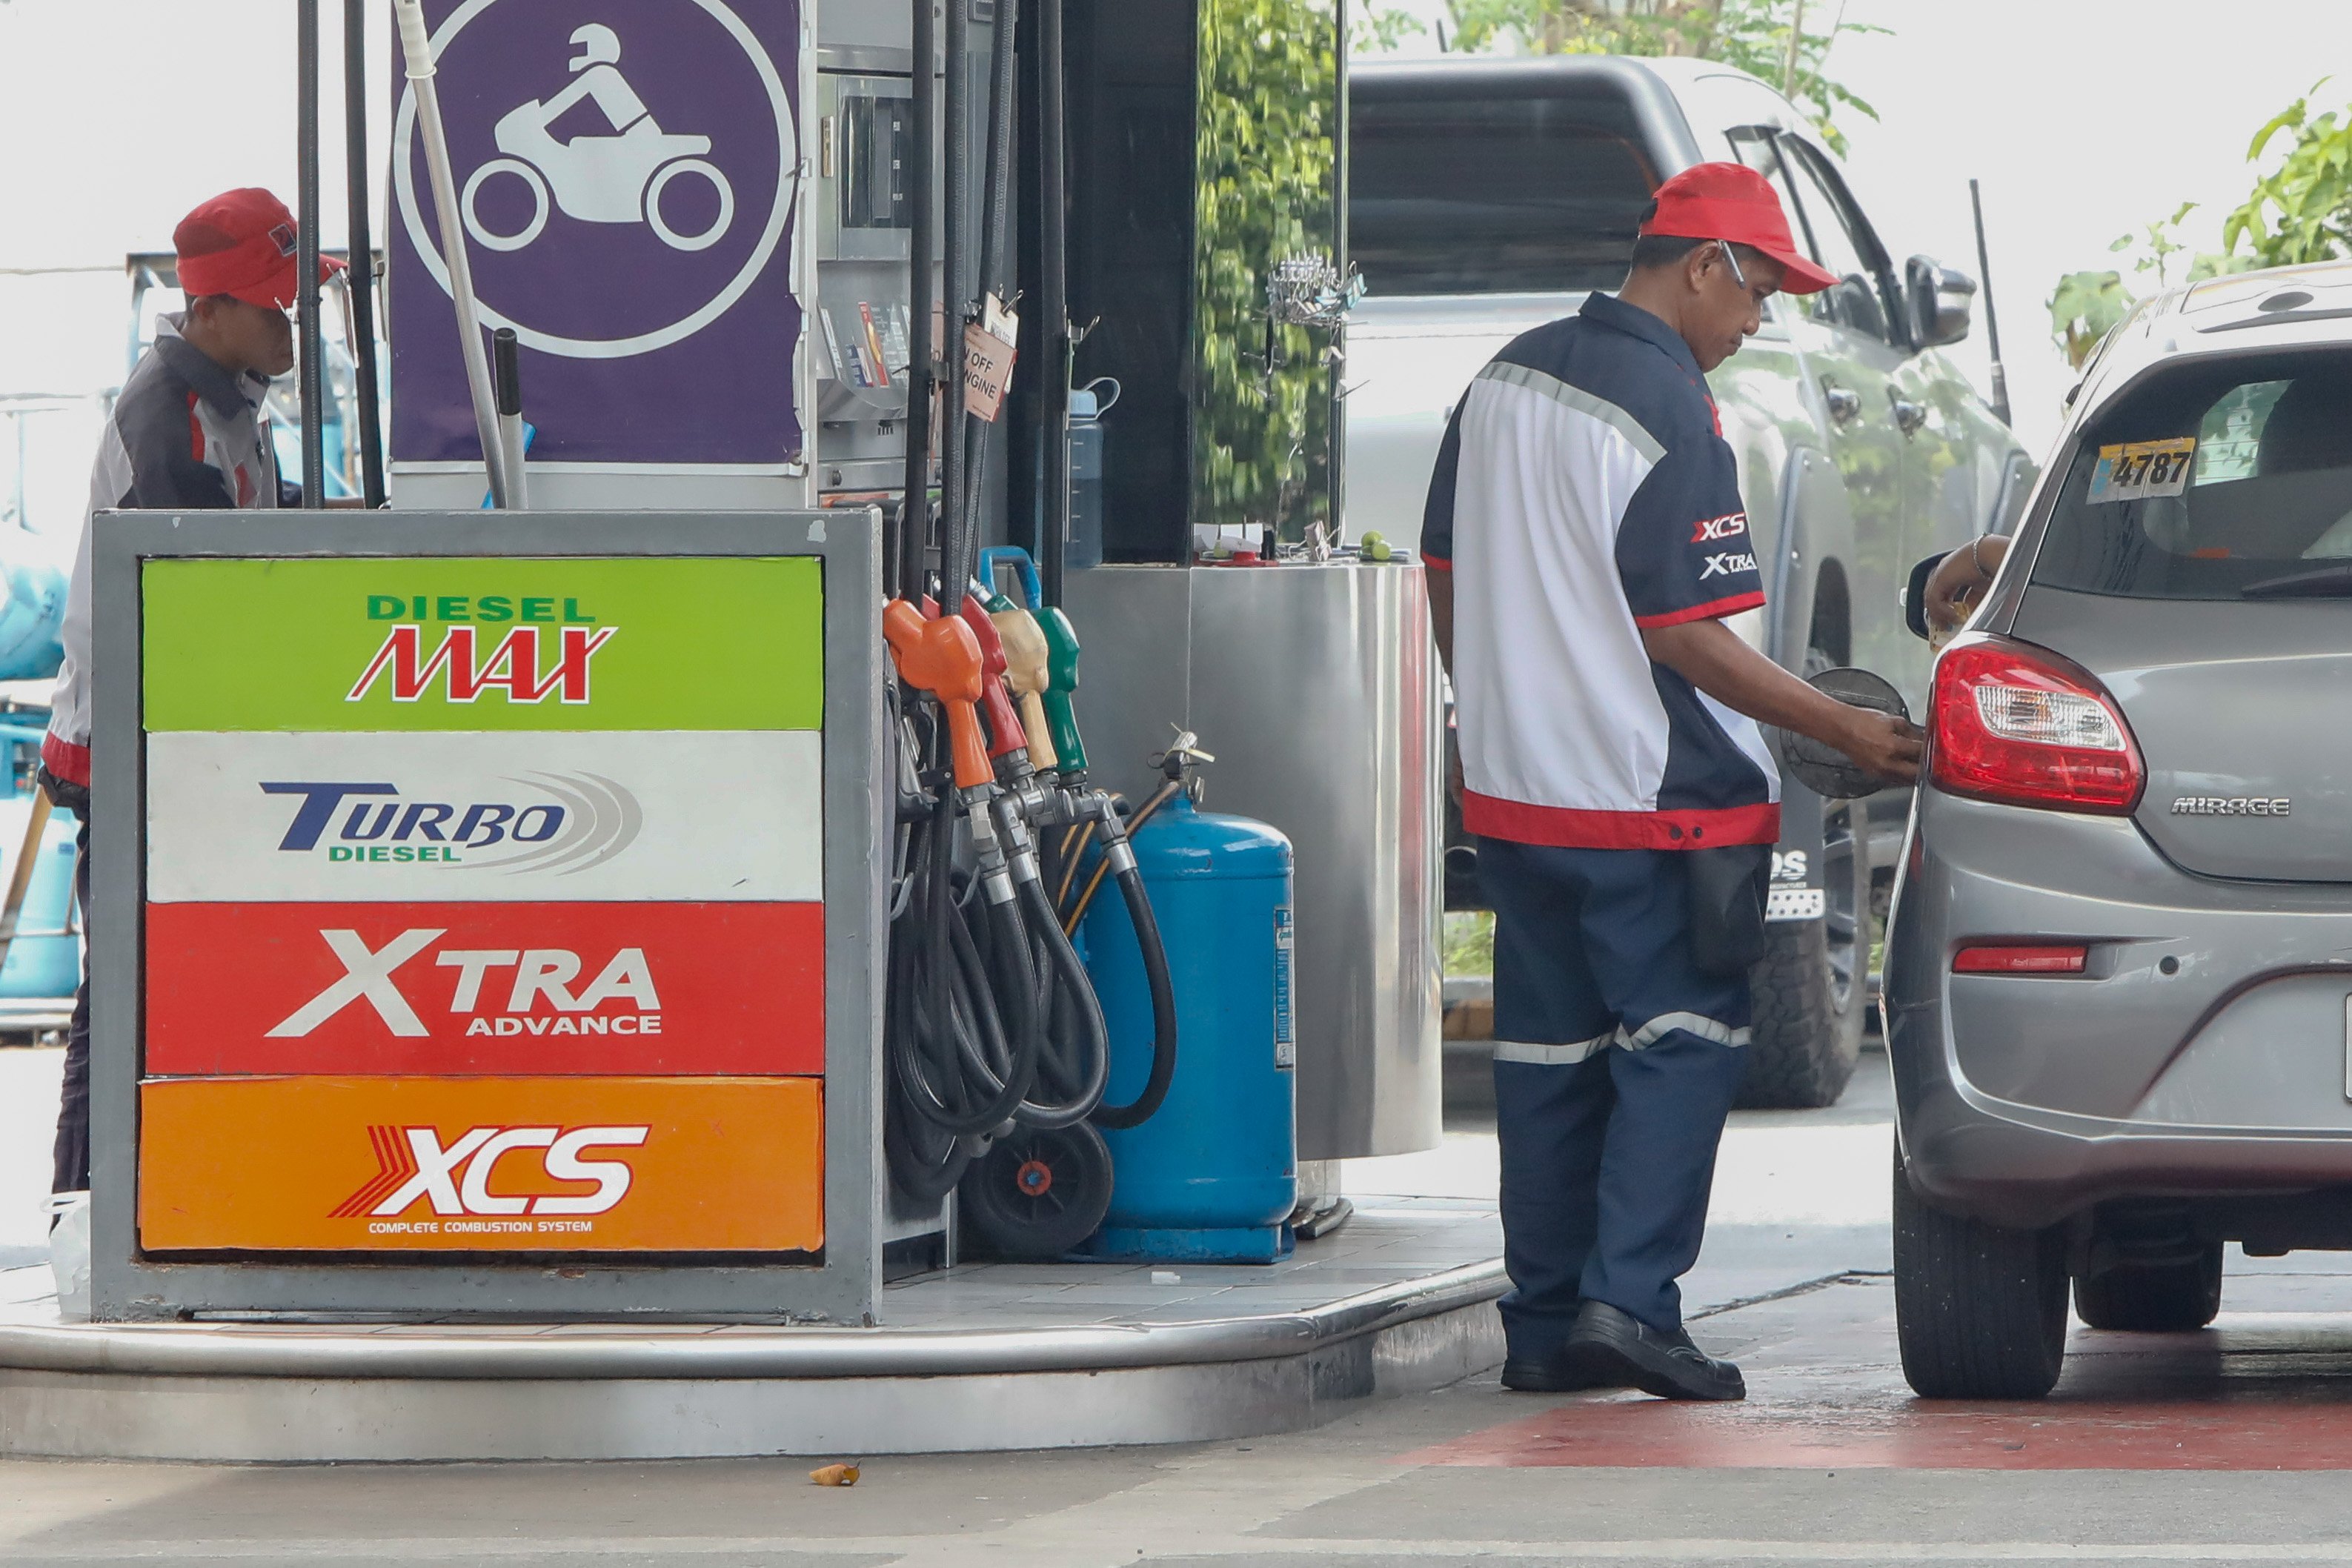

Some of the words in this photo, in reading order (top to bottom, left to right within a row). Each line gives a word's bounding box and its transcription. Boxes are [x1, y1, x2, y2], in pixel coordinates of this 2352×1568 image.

[971, 351, 994, 373] OFF
[964, 368, 997, 400] NGINE
[2113, 451, 2193, 488] 4787
[1697, 511, 1746, 542] XCS
[1698, 552, 1758, 580] XTRA
[367, 595, 597, 622] DIESEL
[345, 624, 619, 704] MAX
[258, 781, 566, 851] TURBO
[2170, 797, 2290, 816] MIRAGE
[328, 846, 462, 863] DIESEL
[263, 928, 662, 1037] XTRA
[465, 1015, 662, 1037] ADVANCE
[362, 1123, 654, 1217] XCS
[368, 1221, 439, 1234] COMPLETE
[444, 1220, 533, 1233] COMBUSTION
[537, 1220, 593, 1232] SYSTEM
